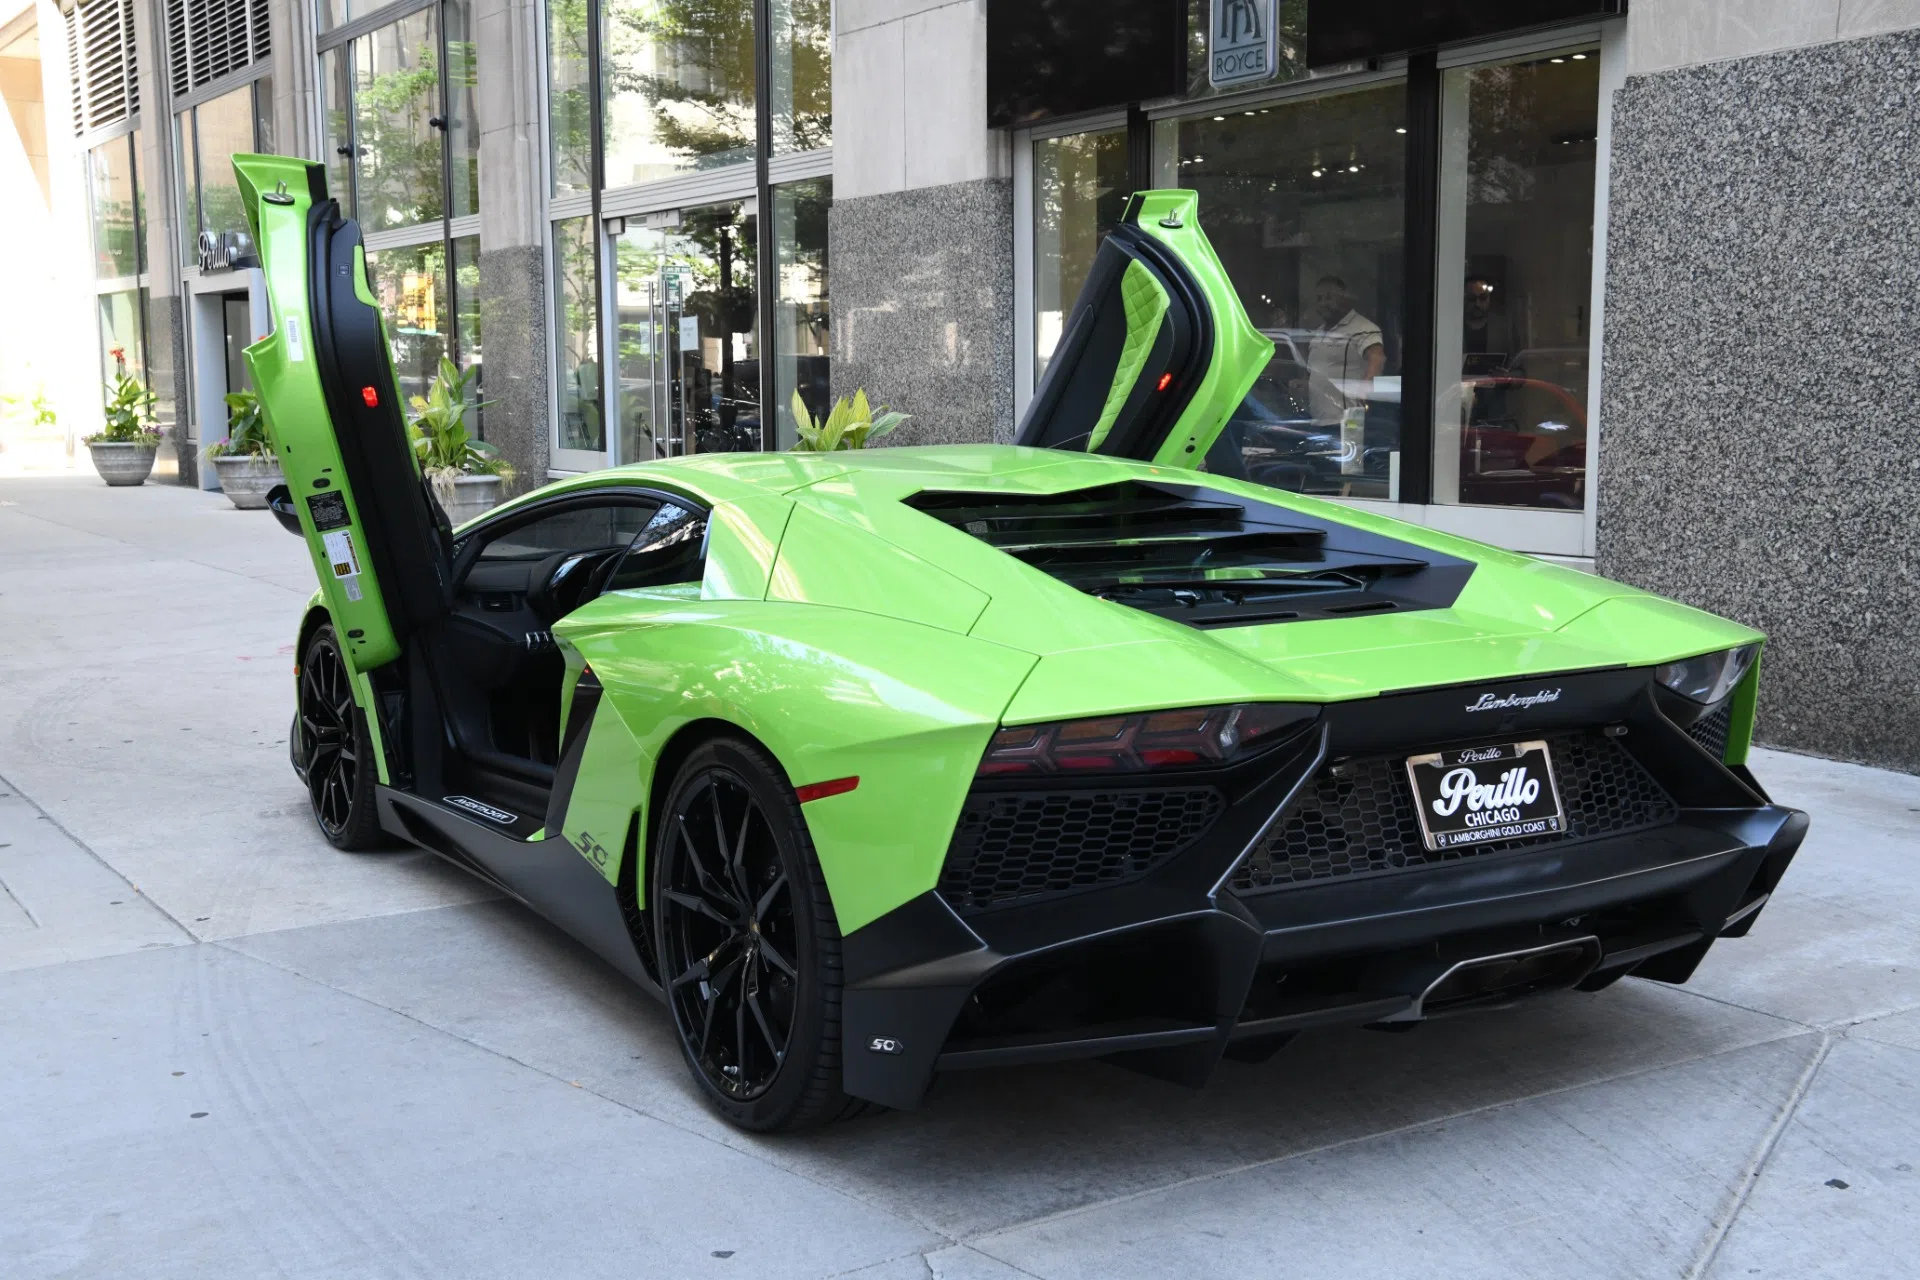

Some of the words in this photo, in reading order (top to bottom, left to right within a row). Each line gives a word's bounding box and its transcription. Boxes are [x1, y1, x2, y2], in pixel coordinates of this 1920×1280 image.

[1216, 49, 1263, 75] ROYCE
[199, 231, 230, 272] Perillo
[1465, 688, 1561, 712] Lamborghini
[1458, 748, 1502, 764] Perillo
[1432, 767, 1540, 817] Perillo
[1465, 807, 1520, 827] CHICAGO
[1449, 827, 1501, 844] LAMBORGHINI
[1501, 824, 1522, 836] GOLD
[1523, 821, 1546, 833] COAST
